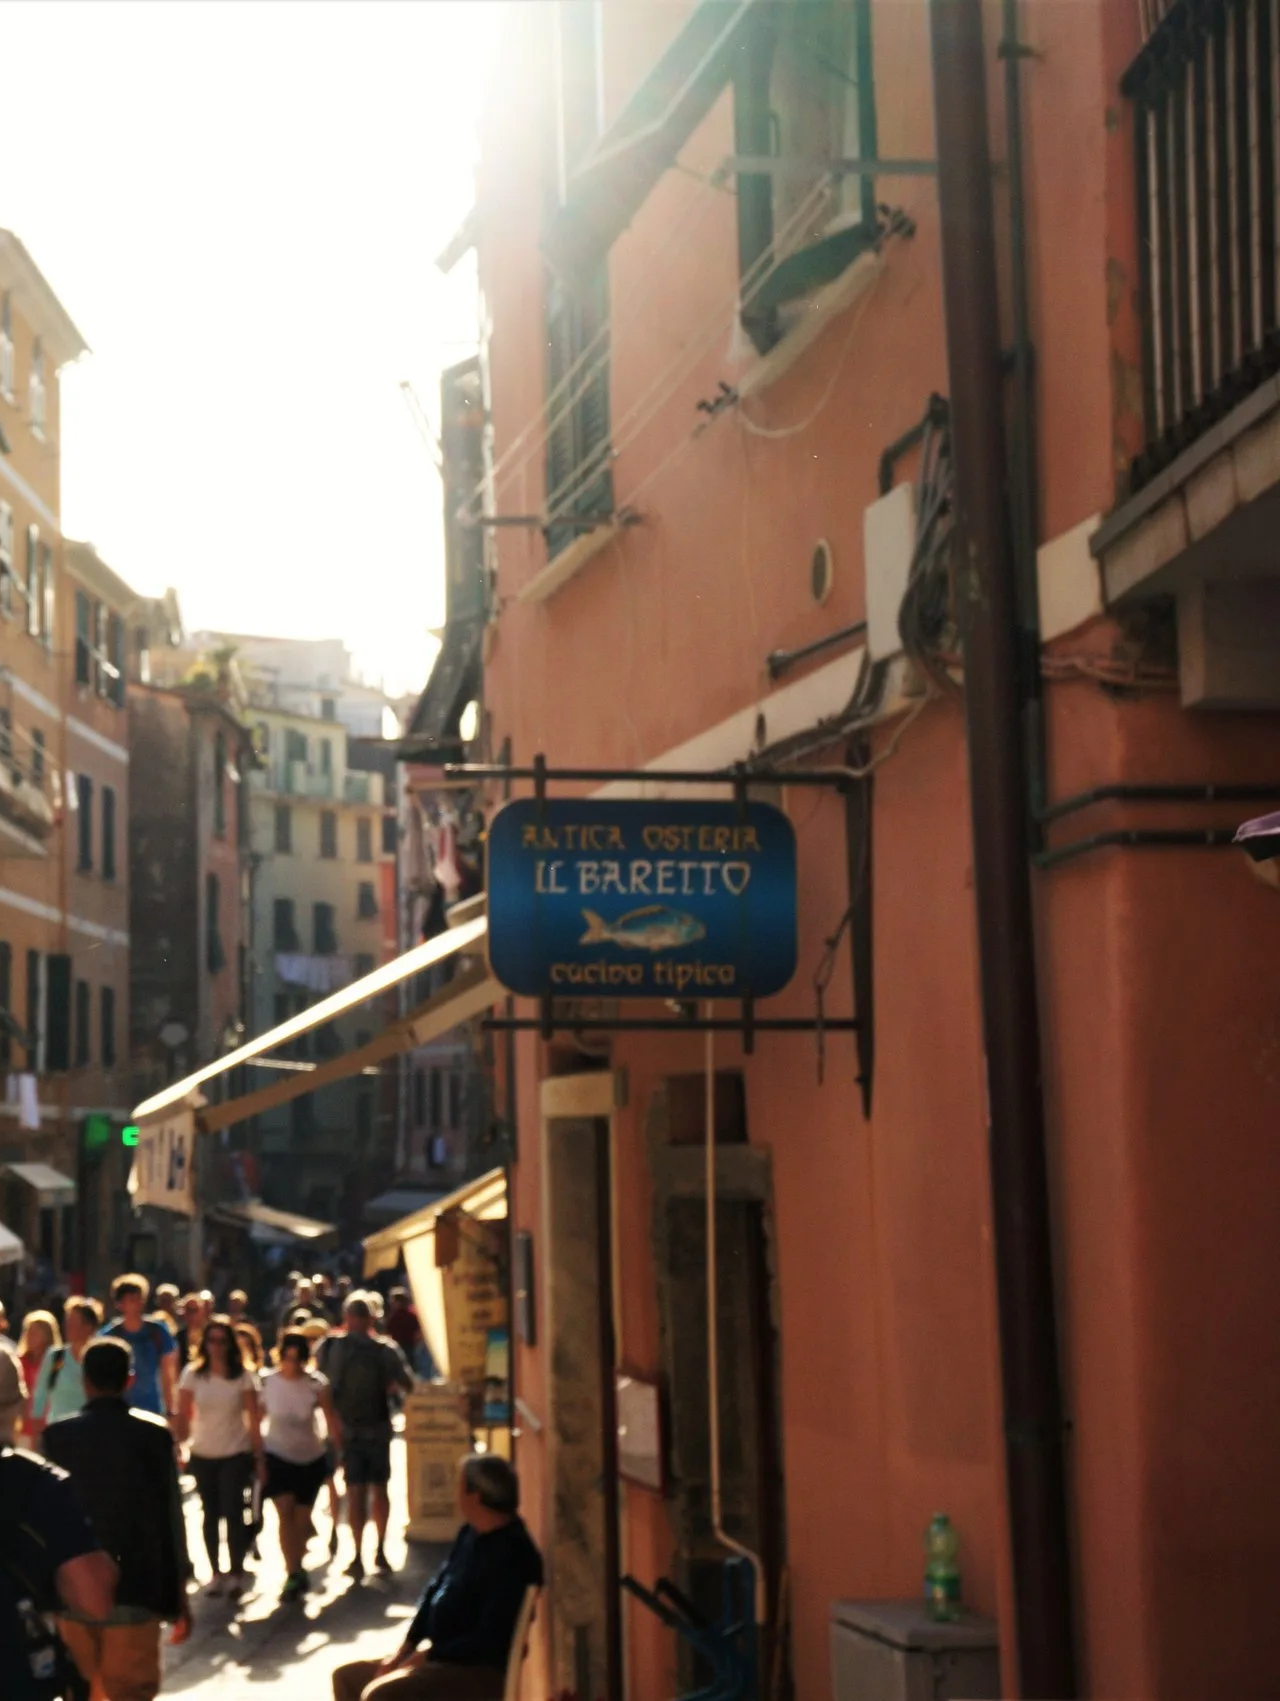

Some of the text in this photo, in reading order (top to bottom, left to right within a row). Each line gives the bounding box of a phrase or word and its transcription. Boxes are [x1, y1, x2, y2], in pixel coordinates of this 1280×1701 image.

[522, 824, 761, 851] ANTICA OSTERIA
[534, 860, 751, 895] IL BARETTO
